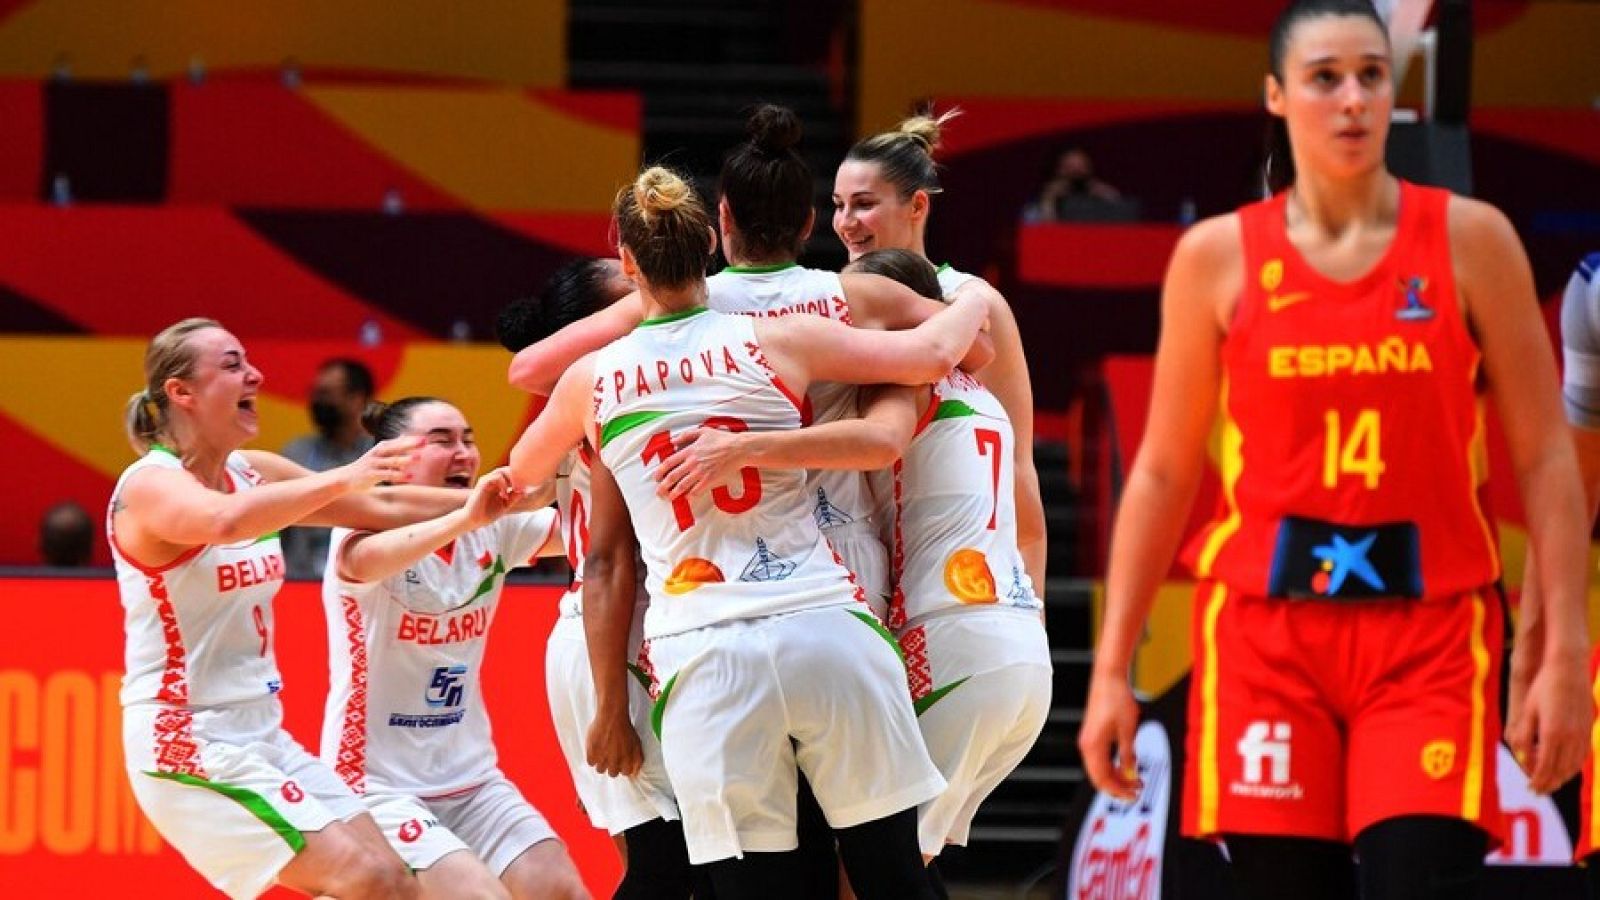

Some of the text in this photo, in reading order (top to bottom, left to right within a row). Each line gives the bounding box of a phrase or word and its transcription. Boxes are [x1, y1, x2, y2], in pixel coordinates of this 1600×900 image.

[613, 345, 741, 404] PAPOVA
[1269, 335, 1434, 379] ESPAÑA
[1323, 409, 1386, 489] 14
[974, 428, 1001, 531] 7
[398, 607, 489, 645] BELARU
[1237, 721, 1291, 783] fi
[1229, 783, 1304, 800] network
